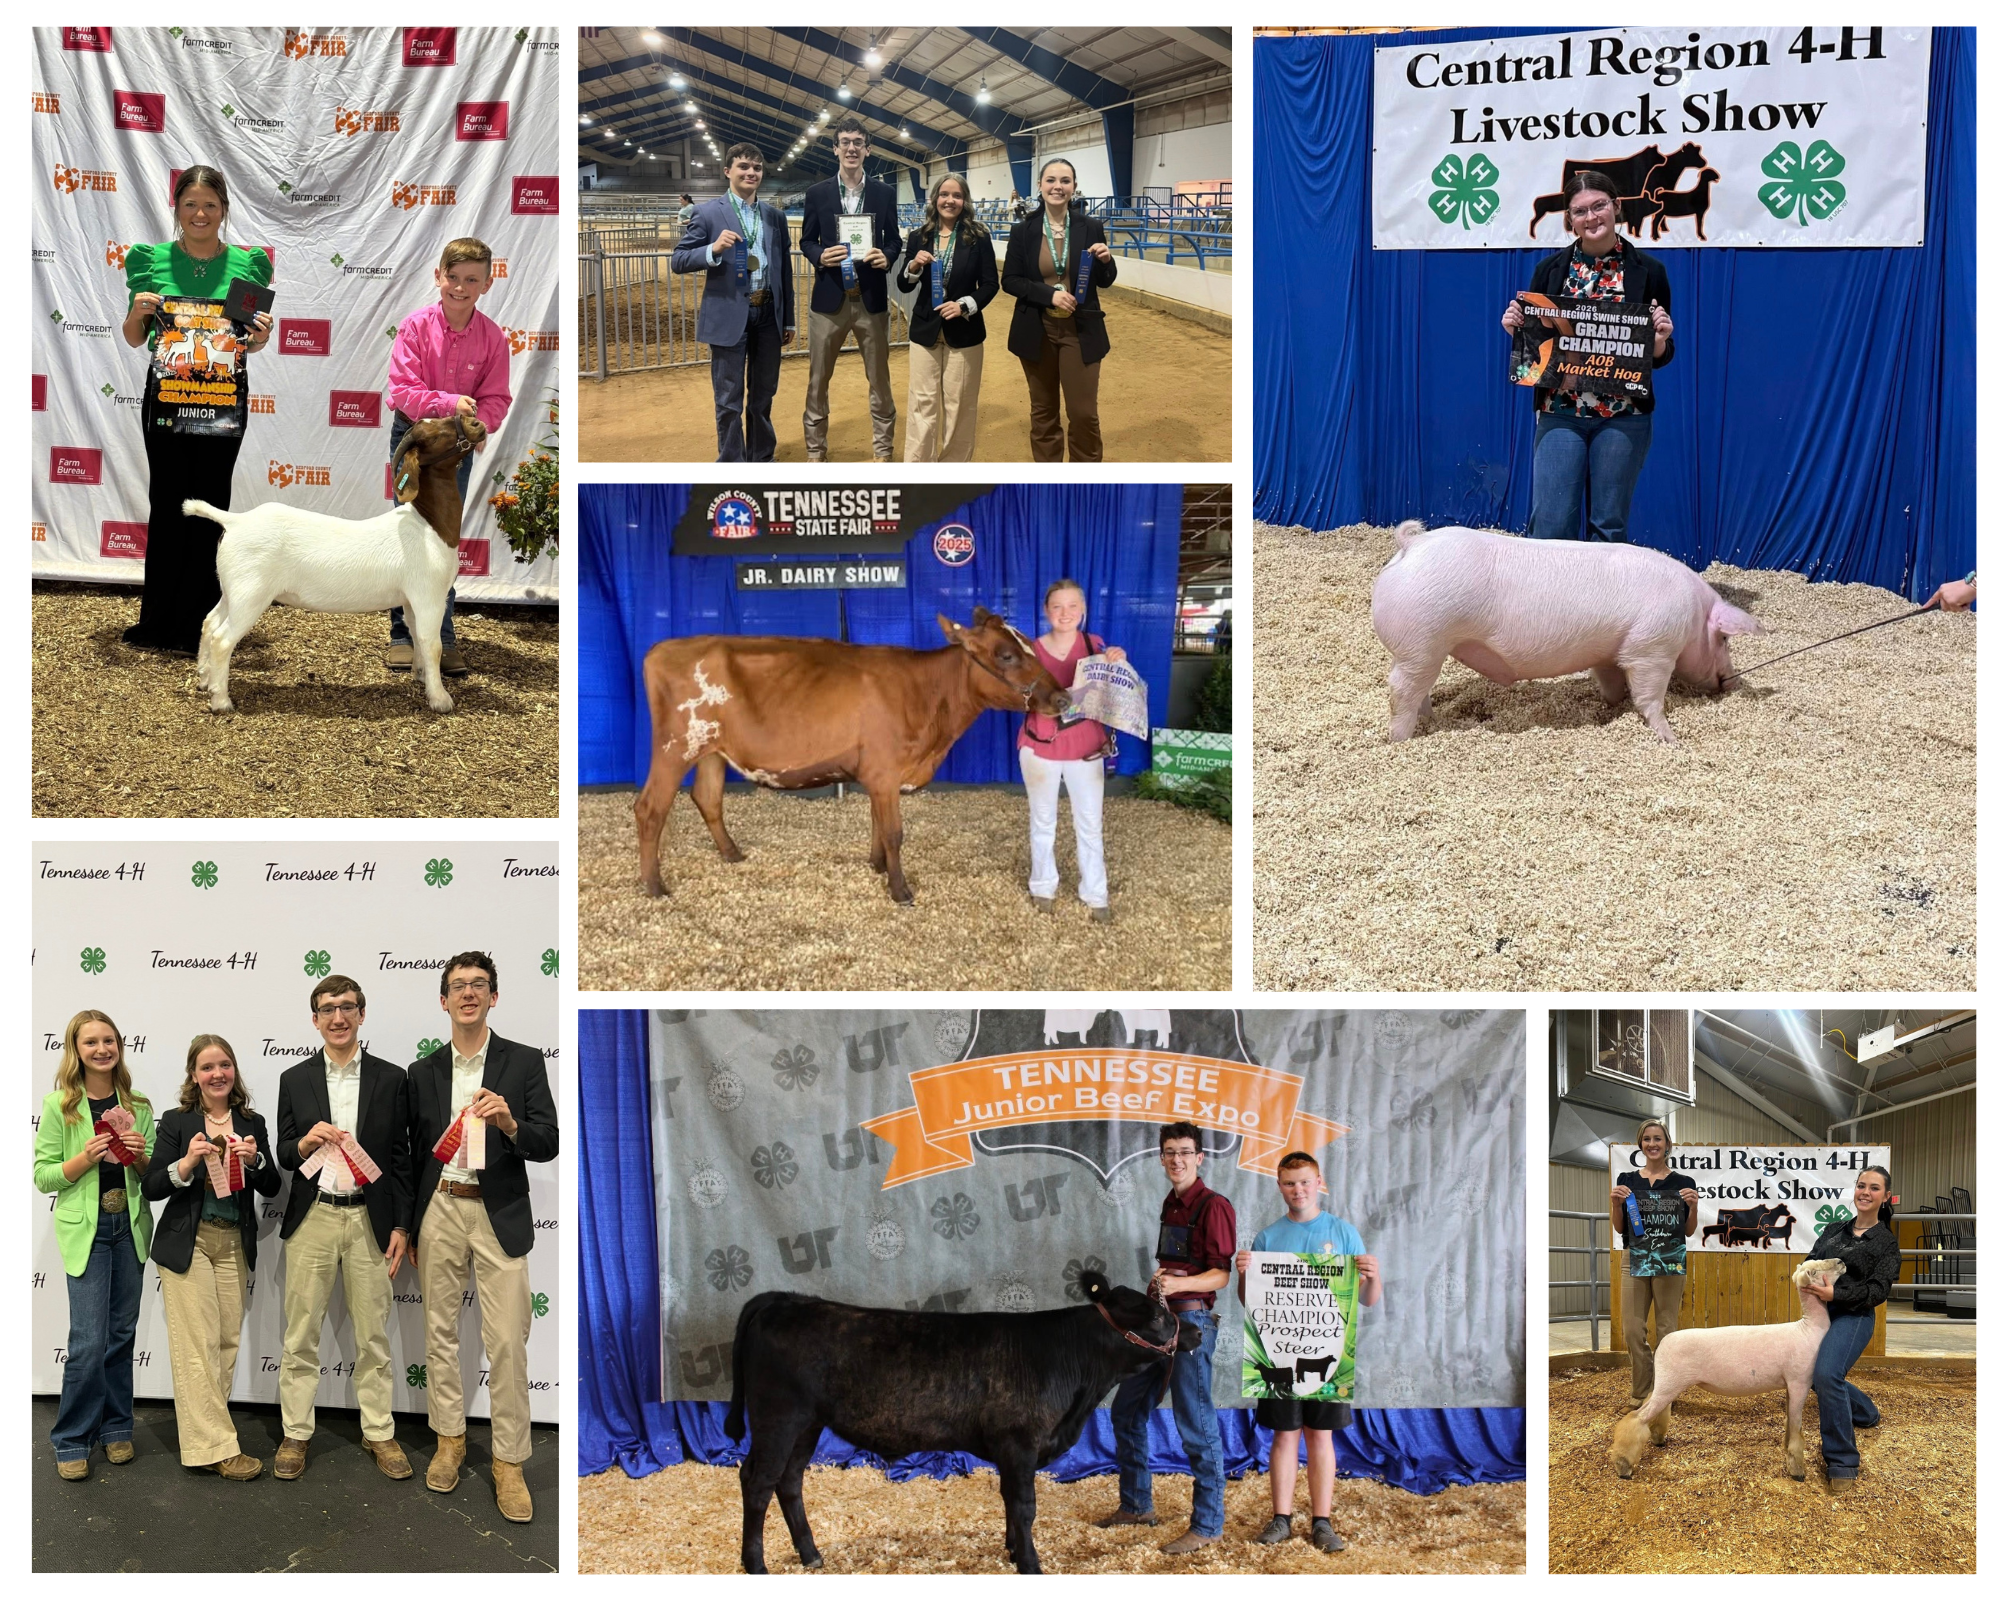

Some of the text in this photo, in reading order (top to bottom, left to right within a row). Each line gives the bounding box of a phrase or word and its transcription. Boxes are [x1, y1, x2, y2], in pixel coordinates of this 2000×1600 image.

[70, 32, 97, 41] Bureau
[411, 39, 434, 48] Farm
[310, 40, 347, 56] FAIR
[410, 48, 440, 56] Bureau
[1406, 26, 1887, 91] Central Region 4-H
[32, 96, 60, 114] AIR
[121, 102, 142, 113] Farm
[120, 111, 149, 122] Bureau
[464, 114, 487, 123] Farm
[1450, 88, 1828, 144] Livestock Show
[363, 116, 400, 132] FAIR
[463, 122, 492, 131] Bureau
[81, 175, 117, 192] FAIR
[291, 192, 341, 204] farmCREDIT
[420, 190, 457, 206] FAIR
[520, 188, 543, 196] Farm
[519, 196, 550, 206] Bureau
[342, 264, 392, 276] farmCREDIT
[1524, 305, 1649, 326] CENTRAL REGION SWINE SHOW
[1575, 304, 1598, 313] 2026
[62, 321, 112, 333] farmCREDIT
[174, 314, 232, 330] GOAT SHOW
[287, 330, 308, 338] Farm
[1576, 322, 1632, 340] GRAND
[286, 338, 314, 346] Bureau
[528, 336, 559, 351] FAIR
[1558, 336, 1645, 358] CHAMPION
[1585, 354, 1615, 368] AOB
[1556, 362, 1642, 382] Market Hog
[160, 379, 237, 394] SHOWMANSHIP
[114, 394, 144, 406] farmC
[158, 391, 237, 406] CHAMPION
[177, 407, 216, 419] JUNIOR
[247, 400, 276, 414] AIR
[338, 402, 360, 410] Farm
[336, 410, 365, 418] Bureau
[58, 458, 80, 466] Farm
[57, 466, 86, 474] Bureau
[295, 470, 330, 486] FAIR
[707, 490, 762, 520] WILSON COUNTY
[763, 490, 901, 522] TENNESSEE
[720, 525, 751, 538] FAIR
[796, 518, 872, 536] STATE FAIR
[110, 532, 130, 541] Farm
[108, 540, 136, 550] Bureau
[938, 538, 972, 551] 2025
[743, 566, 900, 585] JR. DAIRY SHOW
[1083, 663, 1114, 673] CENTRAL
[1110, 676, 1134, 690] SHOW
[40, 860, 146, 882] Tennessee 4-H
[265, 861, 376, 882] Tennessee 4-H
[151, 950, 258, 970] Tennessee 4-H
[262, 1038, 318, 1056] Tenness
[993, 1059, 1220, 1094] TENNESSEE
[954, 1088, 1260, 1128] Junior Beef Expo
[1630, 1149, 1870, 1176] Cntral Region 4-H
[1697, 1179, 1844, 1200] estock Show
[1640, 1214, 1680, 1226] HAMPION
[1261, 1263, 1344, 1277] CENTRAL REGION
[32, 1272, 46, 1288] -H
[1274, 1277, 1330, 1289] BEEF SHOW
[1264, 1291, 1338, 1308] RESERVE
[1252, 1308, 1349, 1326] CHAMPION
[1258, 1323, 1344, 1341] Prospect
[1273, 1341, 1324, 1355] Steer
[132, 1351, 152, 1367] -H
